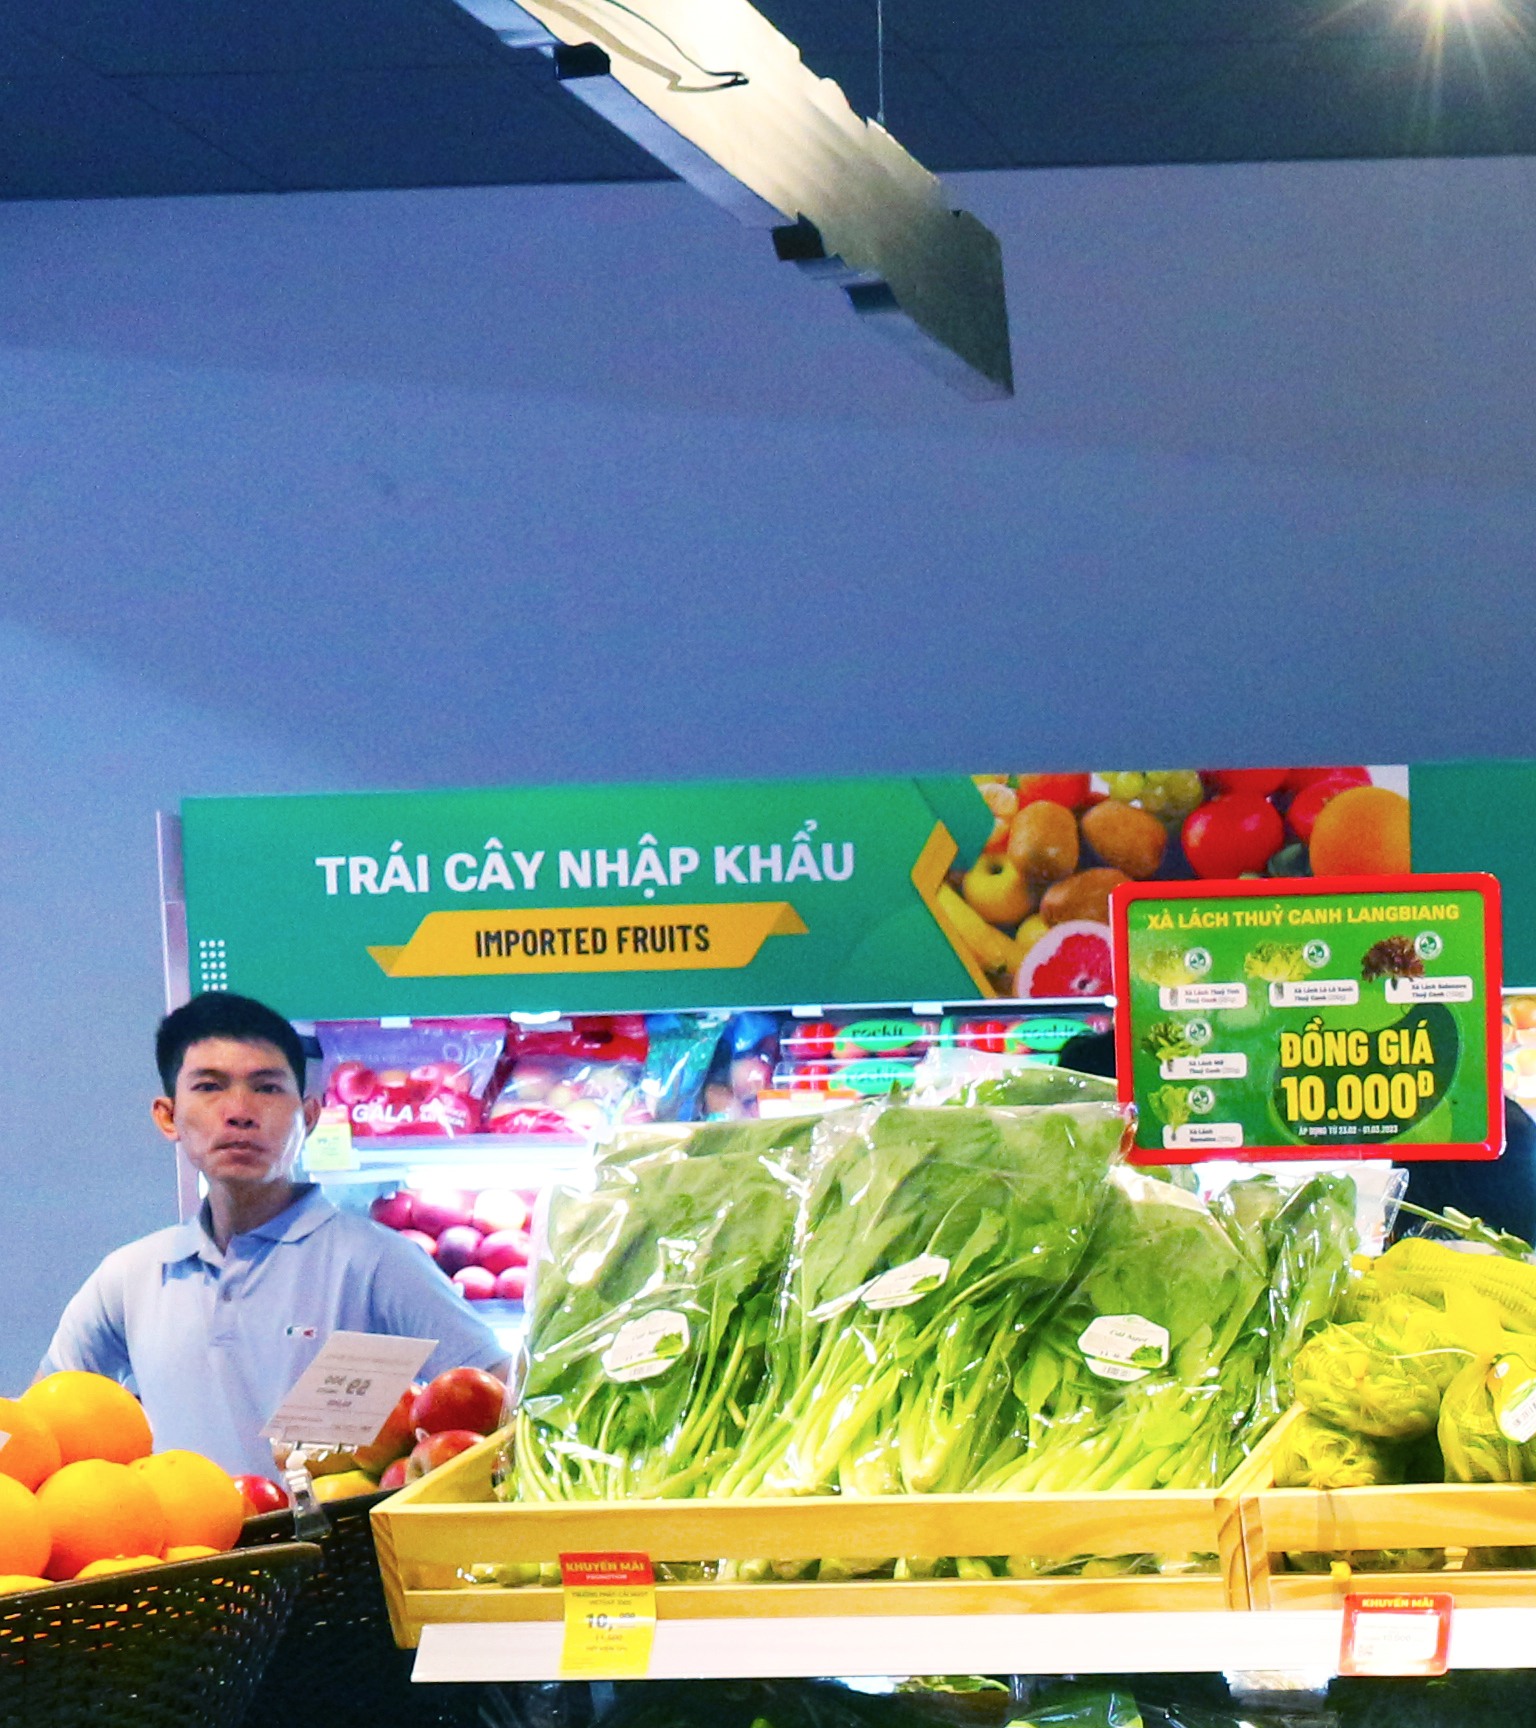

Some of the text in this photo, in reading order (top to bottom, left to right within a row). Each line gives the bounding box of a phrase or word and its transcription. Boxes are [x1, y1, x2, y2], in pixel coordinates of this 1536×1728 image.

[315, 819, 855, 898] TRÁI CÂY NHẬP KHẨU
[1147, 911, 1173, 929] XÀ
[1178, 908, 1229, 929] LÁCH
[1288, 907, 1343, 926] CANH
[1347, 903, 1461, 923] LANGBIANG
[474, 923, 711, 959] IMPORTED FRUITS
[852, 1024, 905, 1040] rockit
[1280, 1015, 1434, 1069] ĐỒNG GIÁ
[351, 1103, 414, 1123] GALA
[1362, 1598, 1410, 1609] KHUYẾN
